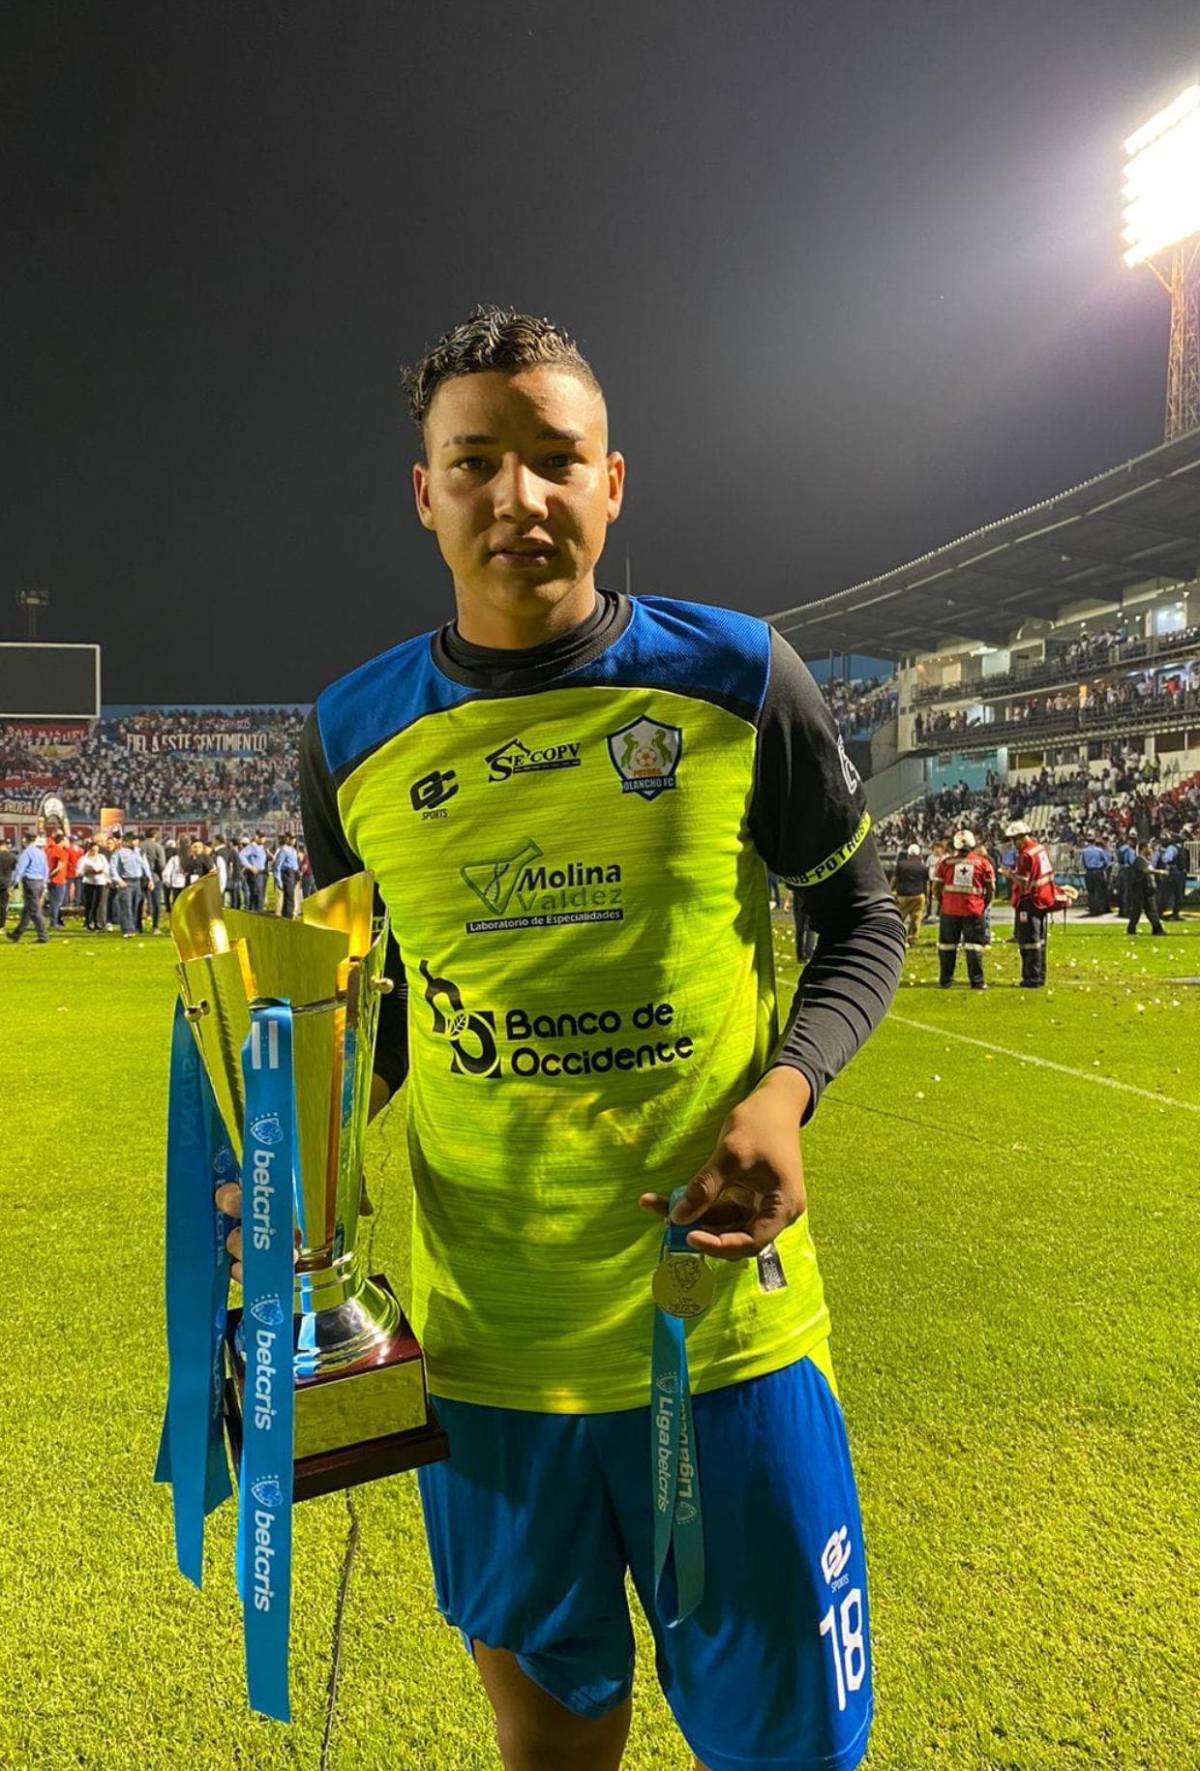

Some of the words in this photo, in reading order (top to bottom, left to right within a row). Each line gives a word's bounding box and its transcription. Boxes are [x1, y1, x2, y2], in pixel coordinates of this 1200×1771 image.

[126, 733, 147, 751] FIEL
[663, 777, 674, 787] FC
[421, 808, 448, 821] SPORTS
[517, 862, 622, 893] Molina
[517, 887, 623, 912] Valdez
[469, 917, 529, 932] Laboratorio
[531, 915, 545, 926] de
[546, 911, 621, 926] Especialidades
[505, 1008, 622, 1041] Banco
[632, 1002, 675, 1030] de
[511, 1036, 694, 1077] Occidente
[253, 1149, 278, 1252] betcris
[254, 1330, 278, 1431] betcris
[254, 1509, 276, 1613] betcris
[830, 1572, 850, 1594] SPORTS
[819, 1587, 866, 1712] 18
